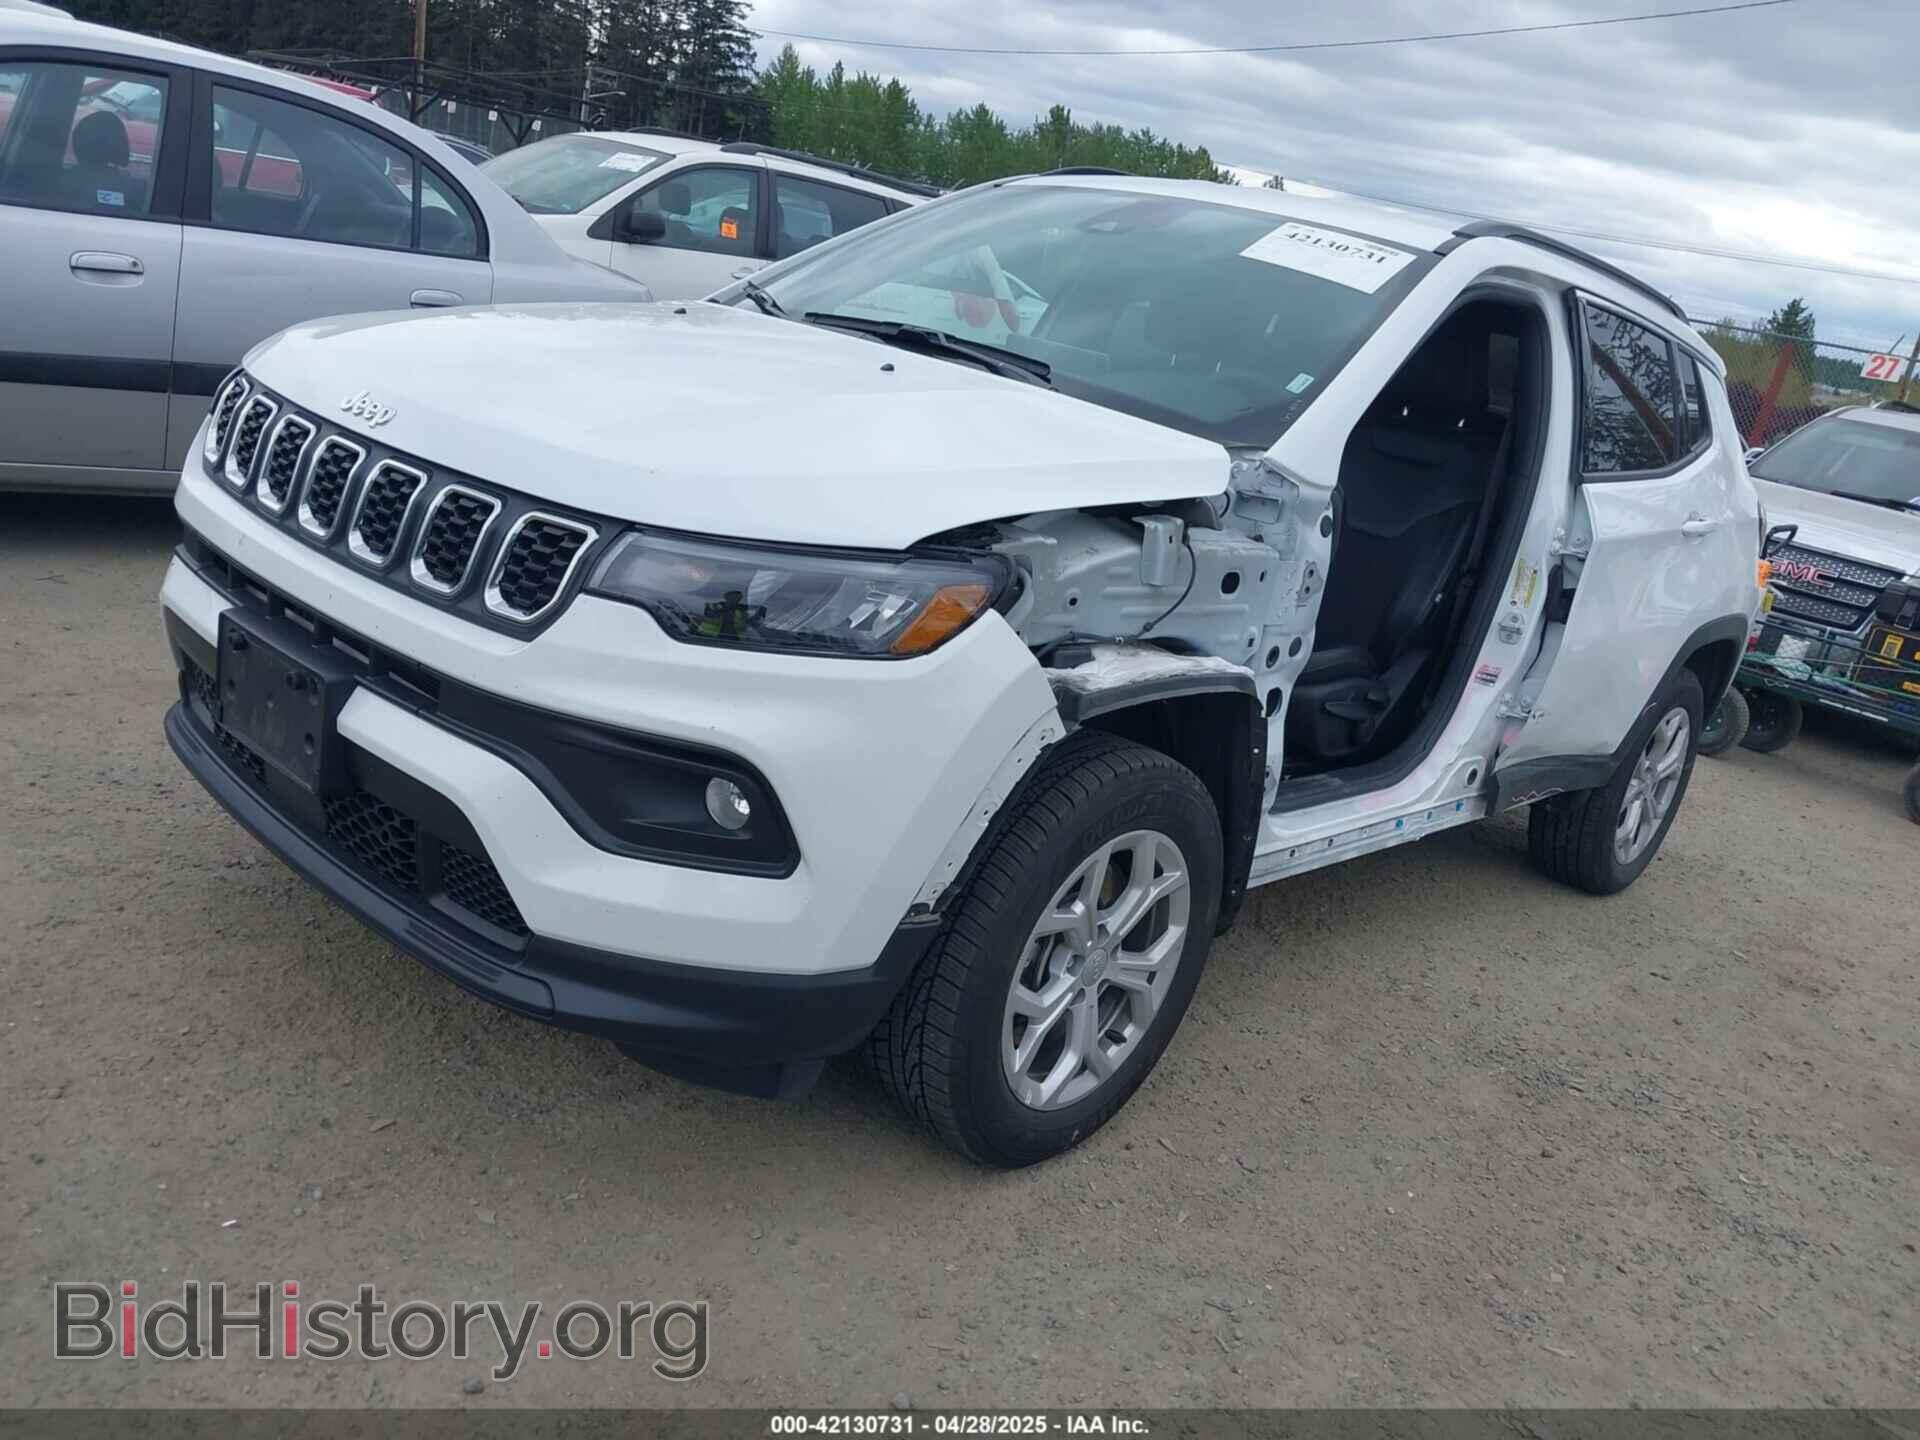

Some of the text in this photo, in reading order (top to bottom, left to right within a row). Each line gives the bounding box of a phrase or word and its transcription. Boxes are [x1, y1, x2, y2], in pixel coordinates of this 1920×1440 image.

[1285, 231, 1387, 264] 42130731
[1866, 355, 1900, 379] 27
[340, 391, 397, 428] Jeep
